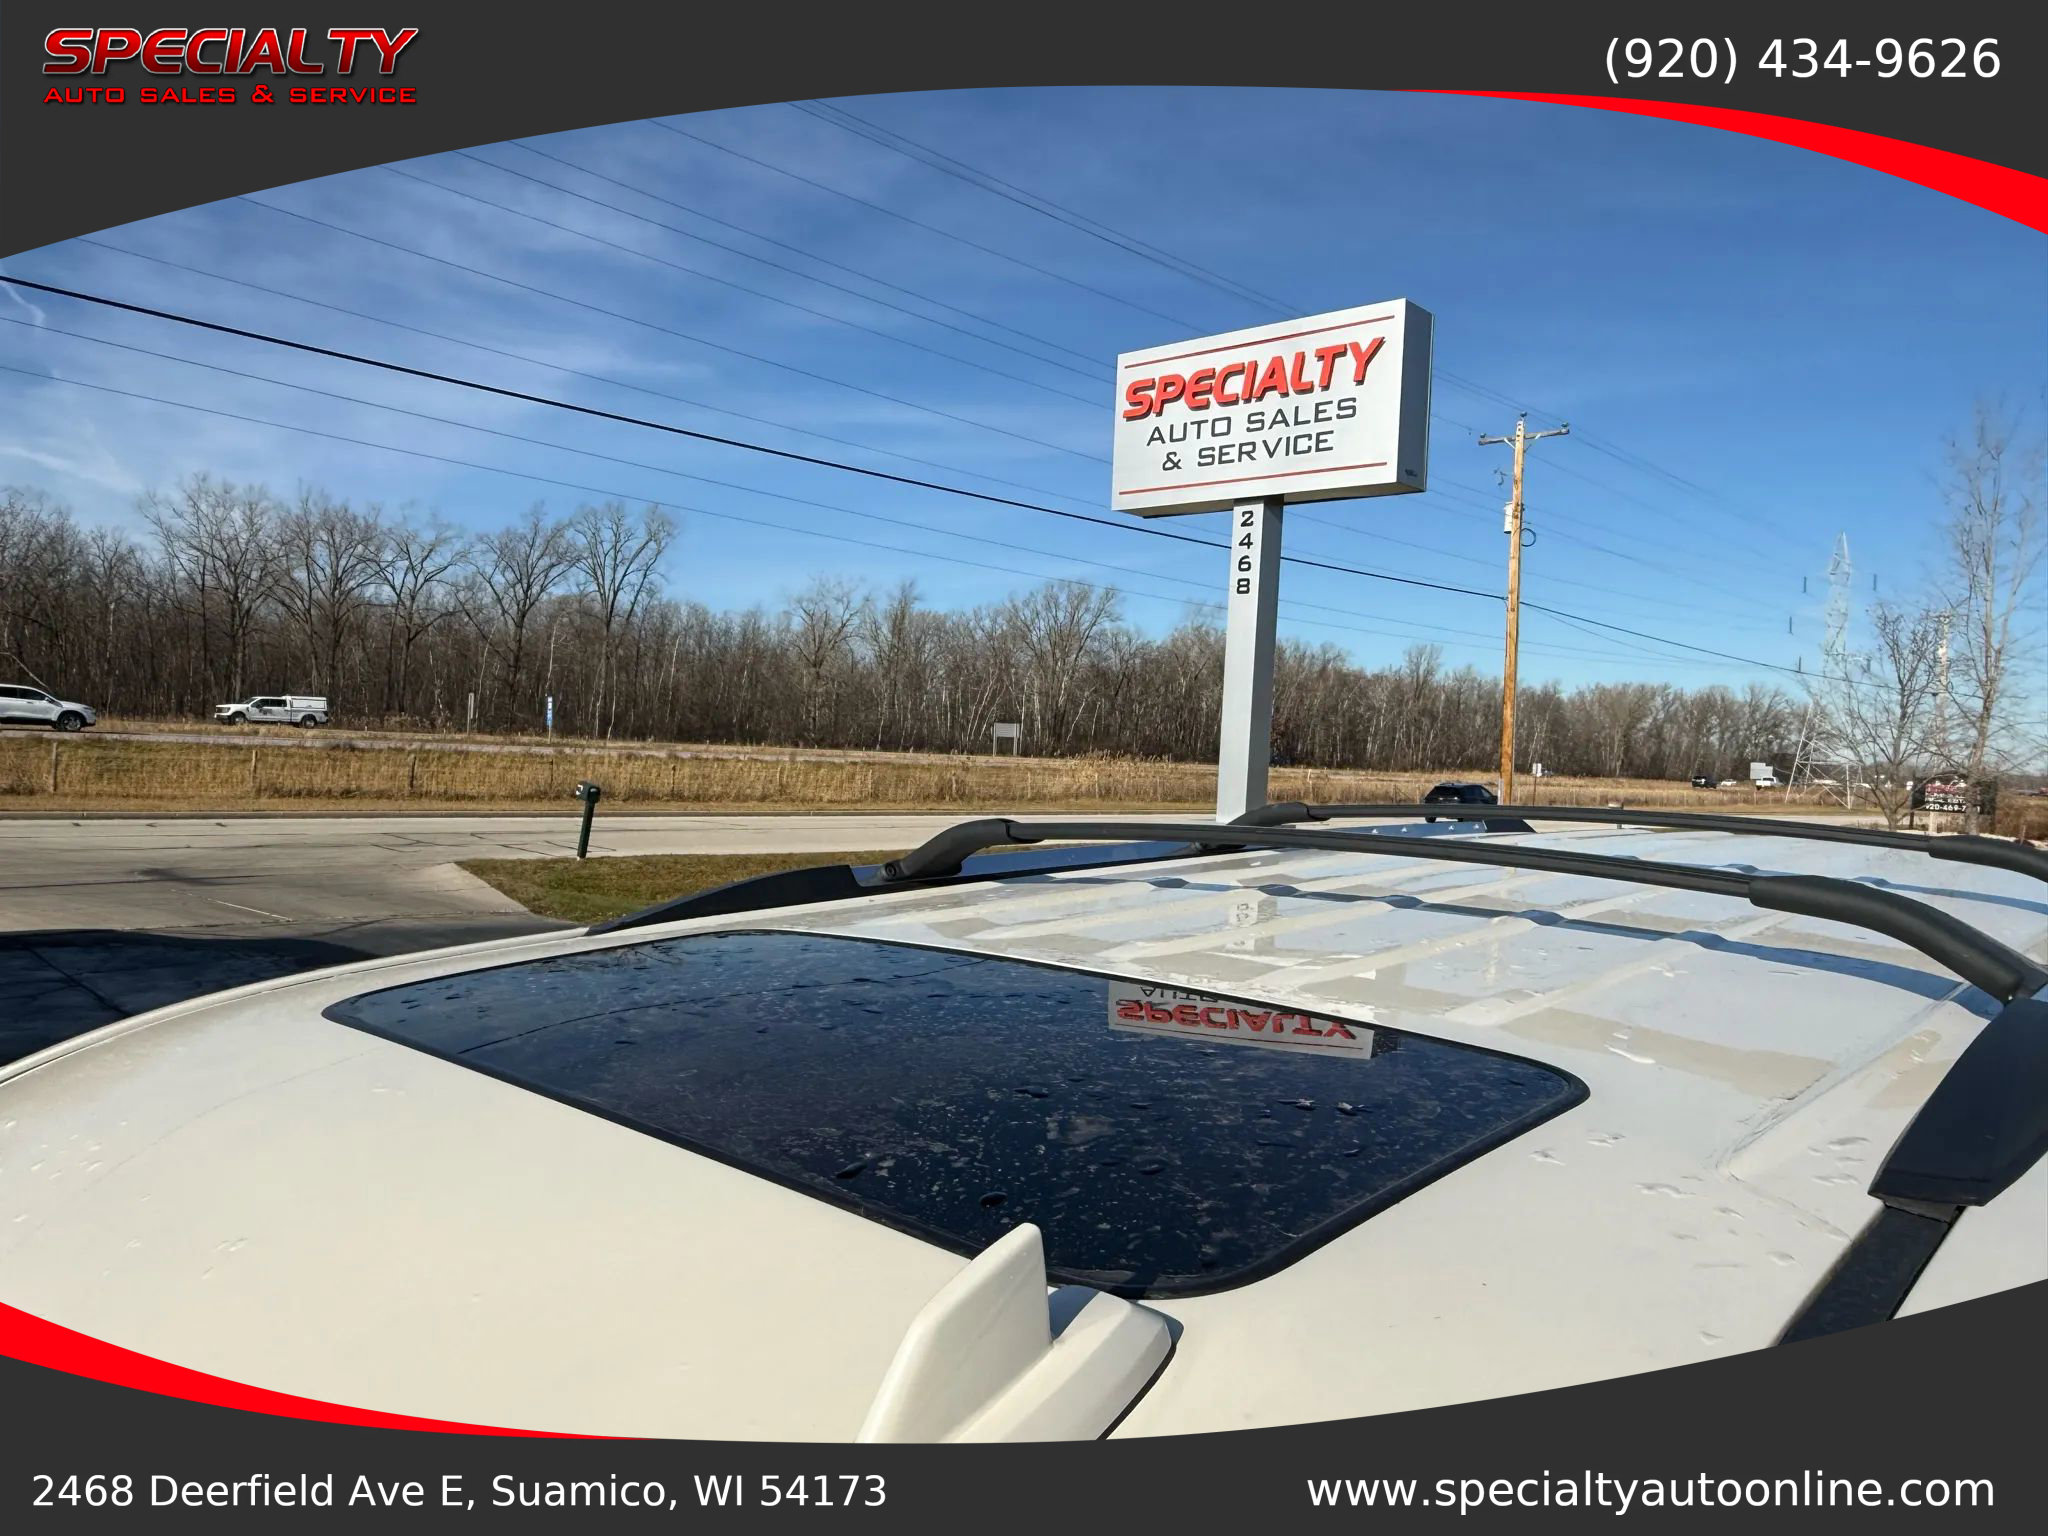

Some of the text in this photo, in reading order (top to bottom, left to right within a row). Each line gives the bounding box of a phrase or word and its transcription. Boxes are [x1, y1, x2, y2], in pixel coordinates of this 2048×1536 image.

[1123, 336, 1385, 421] SPECIALTY
[1147, 396, 1357, 447] AUTO SALES
[1162, 430, 1334, 471] & SERVICE
[1236, 510, 1254, 595] 2468
